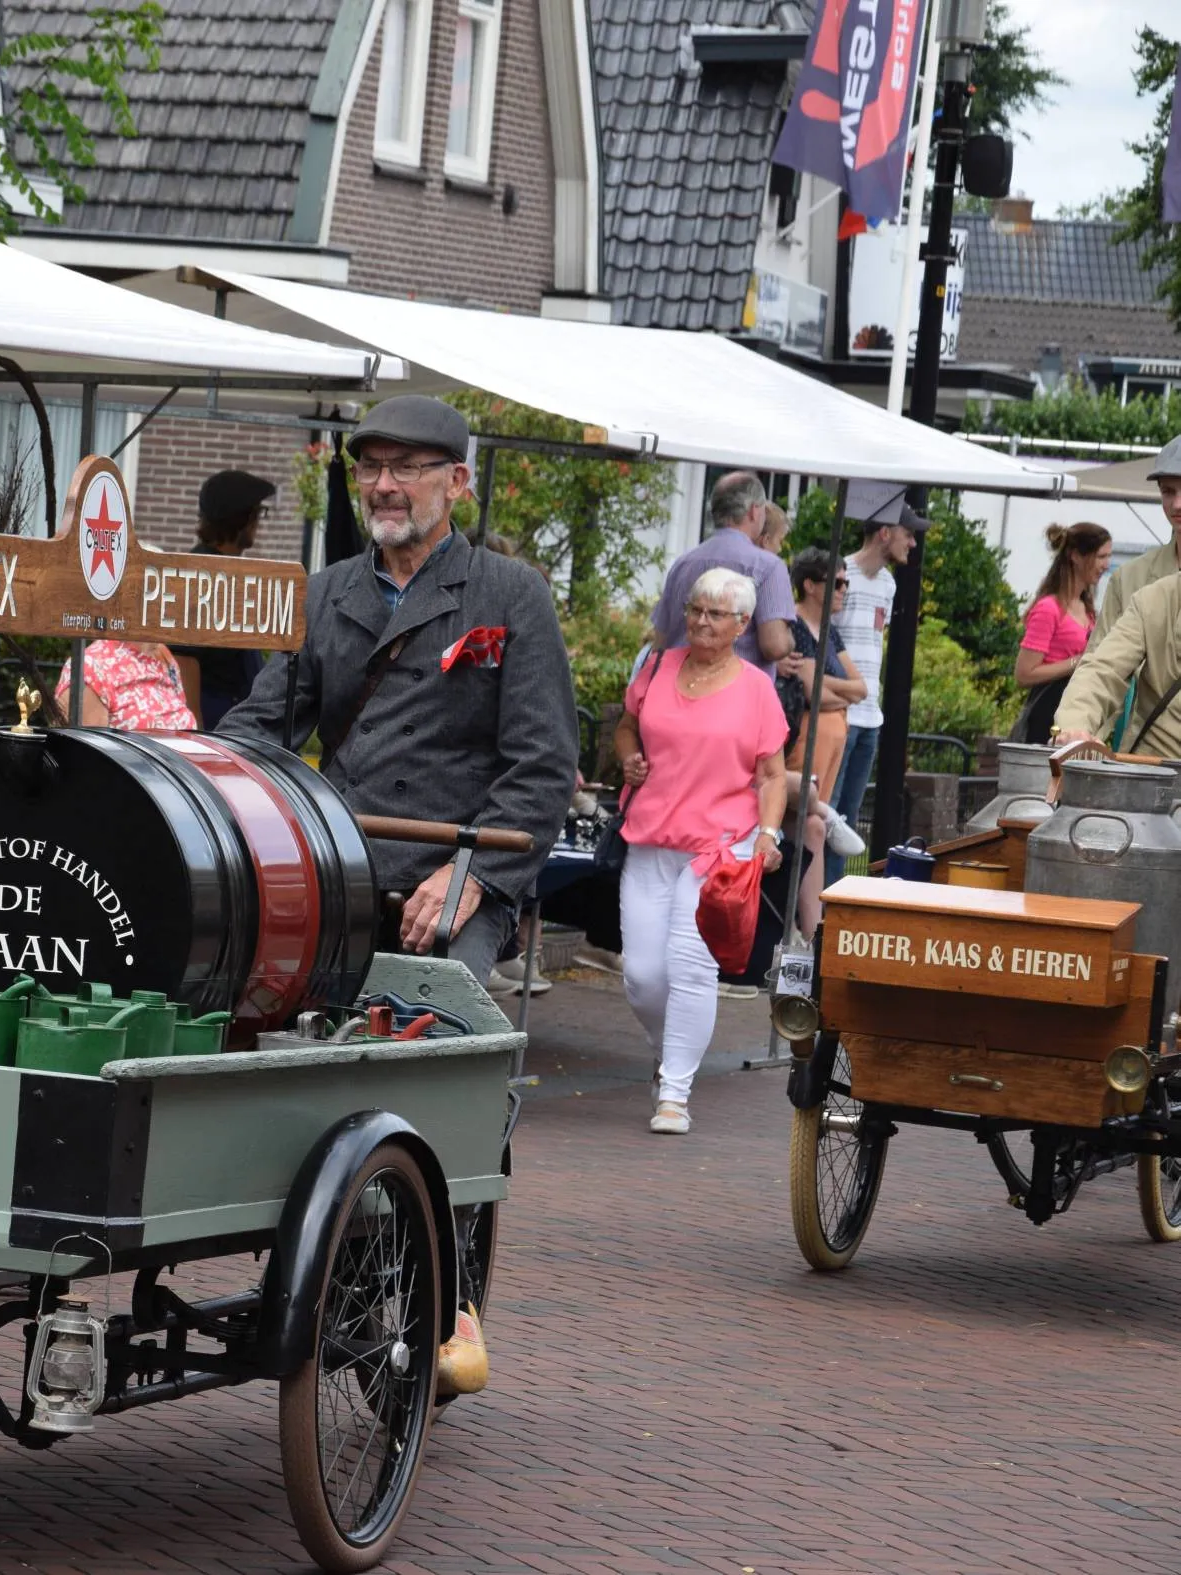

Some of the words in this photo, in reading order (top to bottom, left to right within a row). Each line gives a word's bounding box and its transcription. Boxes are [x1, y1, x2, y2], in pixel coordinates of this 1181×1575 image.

[85, 528, 122, 552] CALTEX
[62, 612, 92, 632] literprijs
[109, 615, 125, 631] cent
[141, 565, 296, 637] PETROLEUM
[49, 845, 135, 948] HANDEL
[837, 929, 917, 967] BOTER,
[924, 938, 981, 970] KAAS
[987, 945, 1004, 972] &
[1010, 947, 1092, 982] EIEREN
